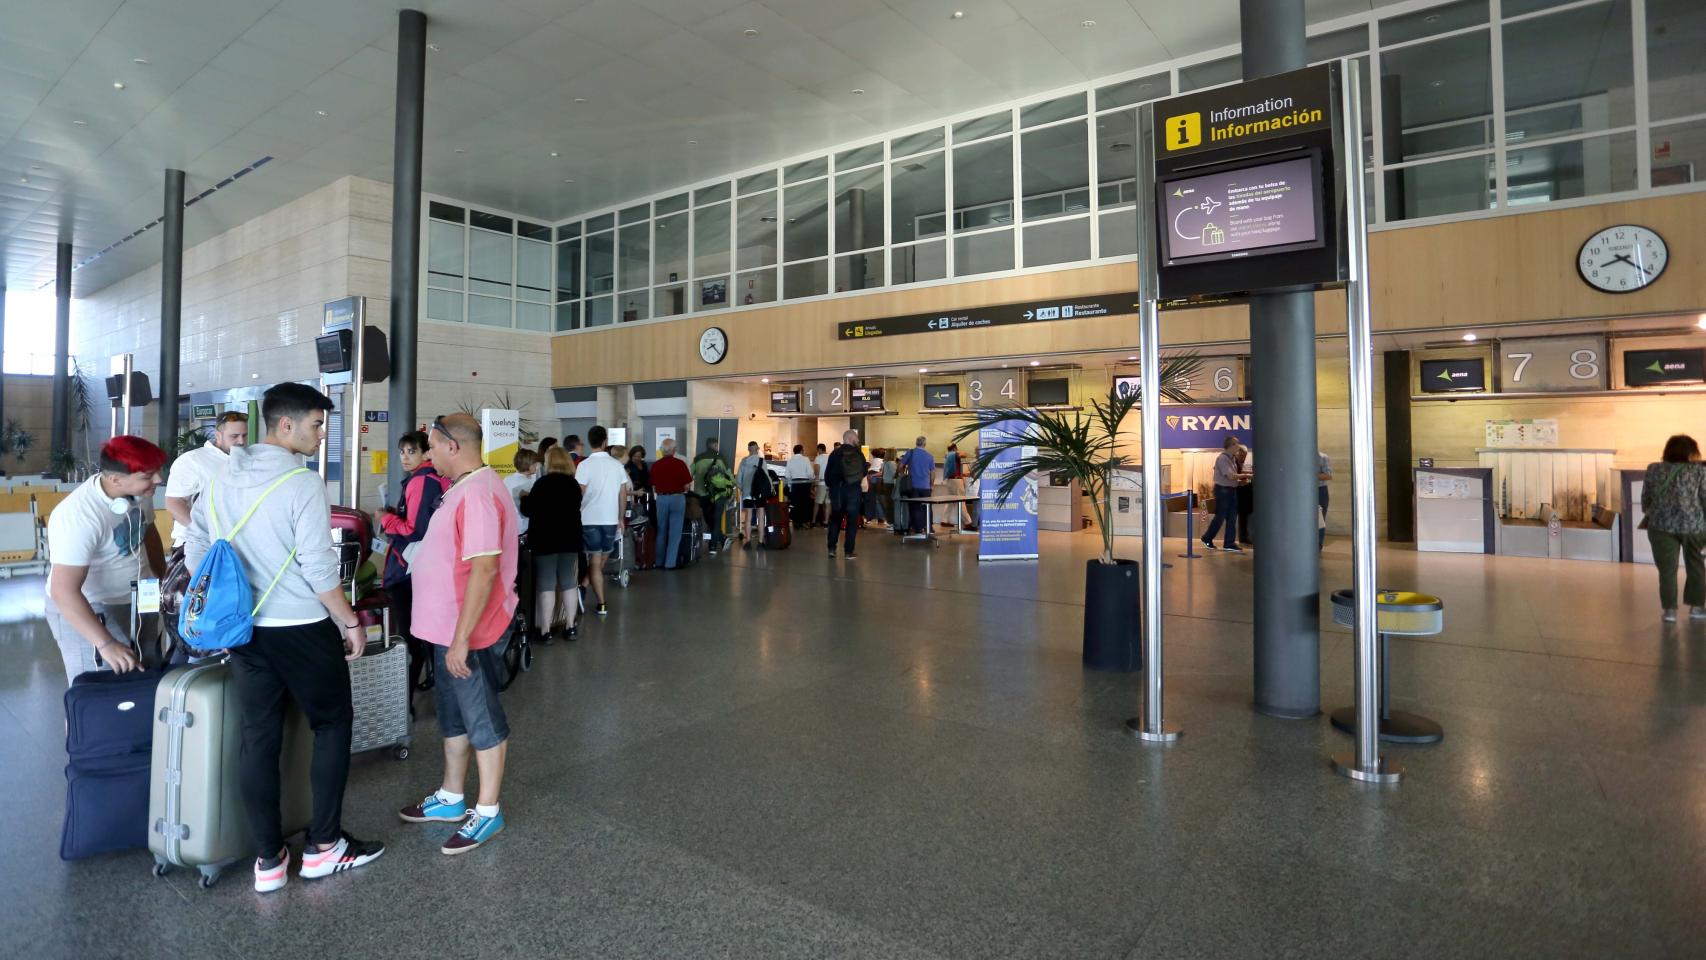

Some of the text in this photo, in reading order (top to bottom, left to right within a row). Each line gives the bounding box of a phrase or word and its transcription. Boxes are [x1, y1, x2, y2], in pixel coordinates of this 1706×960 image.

[1210, 96, 1293, 123] Information
[1211, 108, 1322, 142] Información
[1615, 232, 1624, 240] 12
[1646, 240, 1652, 248] 2
[1590, 248, 1600, 256] 10
[1606, 276, 1612, 284] 7
[951, 320, 968, 328] Alquiler
[1506, 350, 1600, 382] 7 8
[1664, 362, 1686, 370] aena
[1214, 367, 1233, 392] 6
[970, 379, 1015, 400] 3 4
[806, 388, 842, 406] 1 2
[492, 418, 516, 428] vueling
[1182, 414, 1250, 431] RYAN
